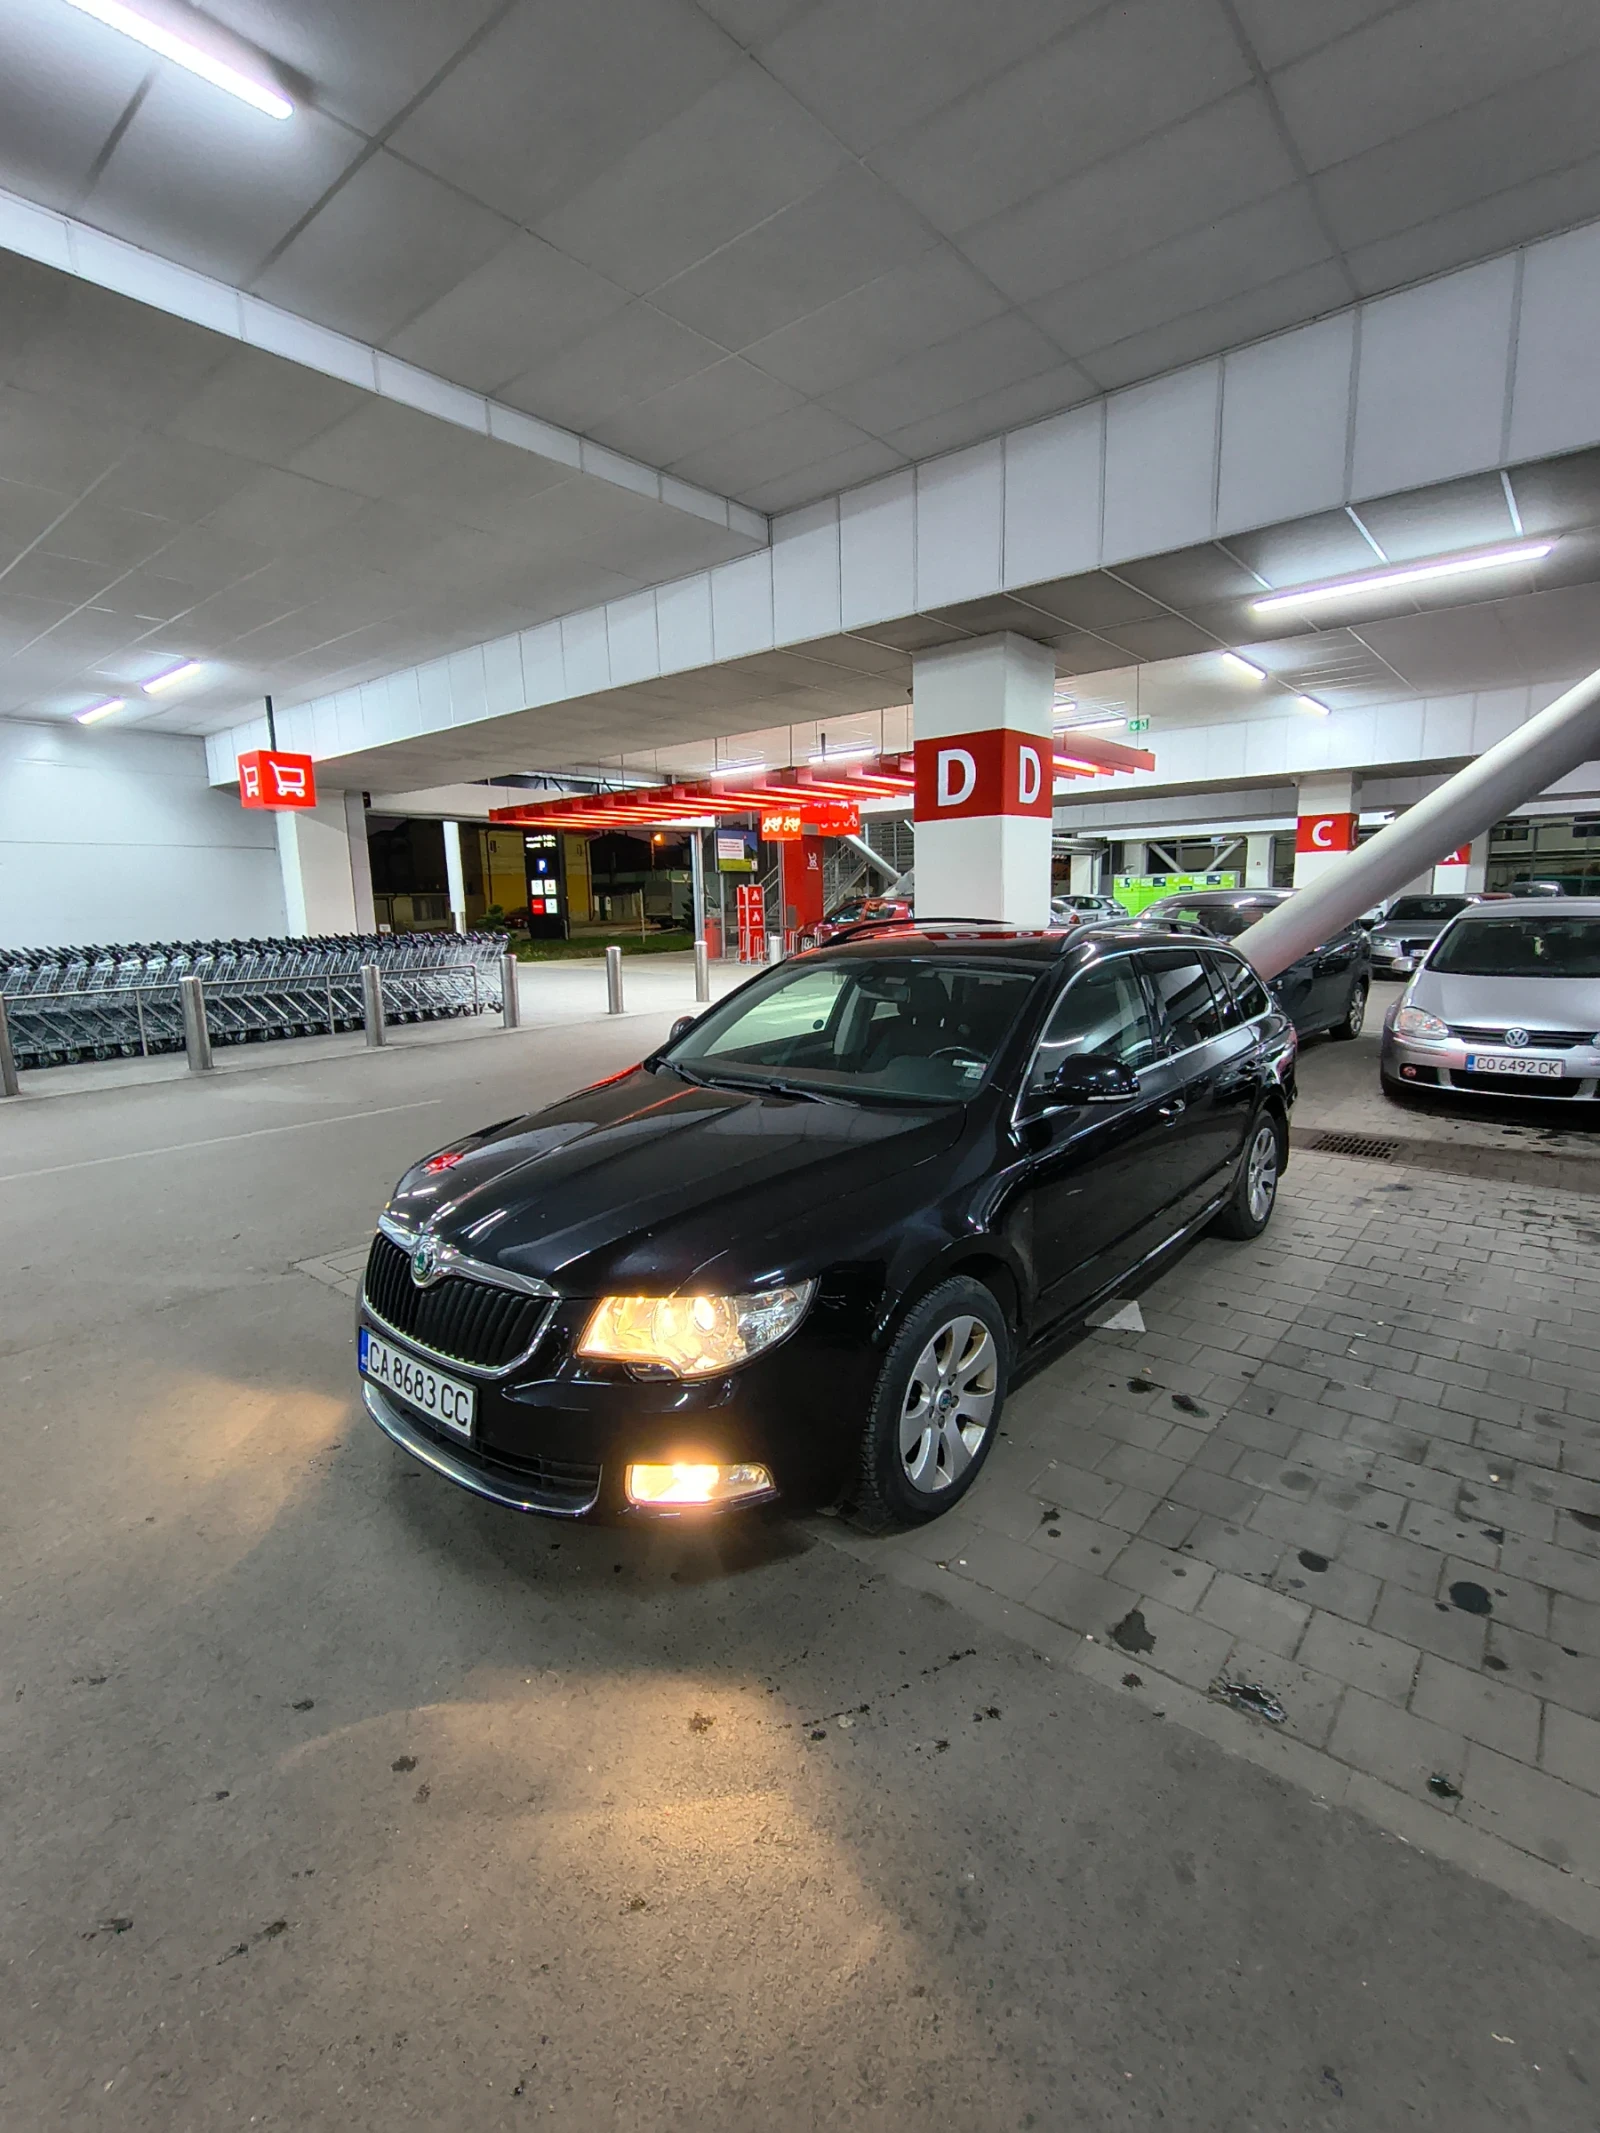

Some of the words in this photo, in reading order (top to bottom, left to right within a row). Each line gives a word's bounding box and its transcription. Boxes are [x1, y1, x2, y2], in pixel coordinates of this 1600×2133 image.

[937, 748, 977, 807] D
[1018, 745, 1041, 804] D
[1311, 820, 1334, 847] C
[1498, 1060, 1536, 1074] 6492
[1538, 1062, 1559, 1075] CK
[370, 1342, 389, 1381] CA
[393, 1357, 436, 1409] 8683
[441, 1384, 469, 1426] CC
